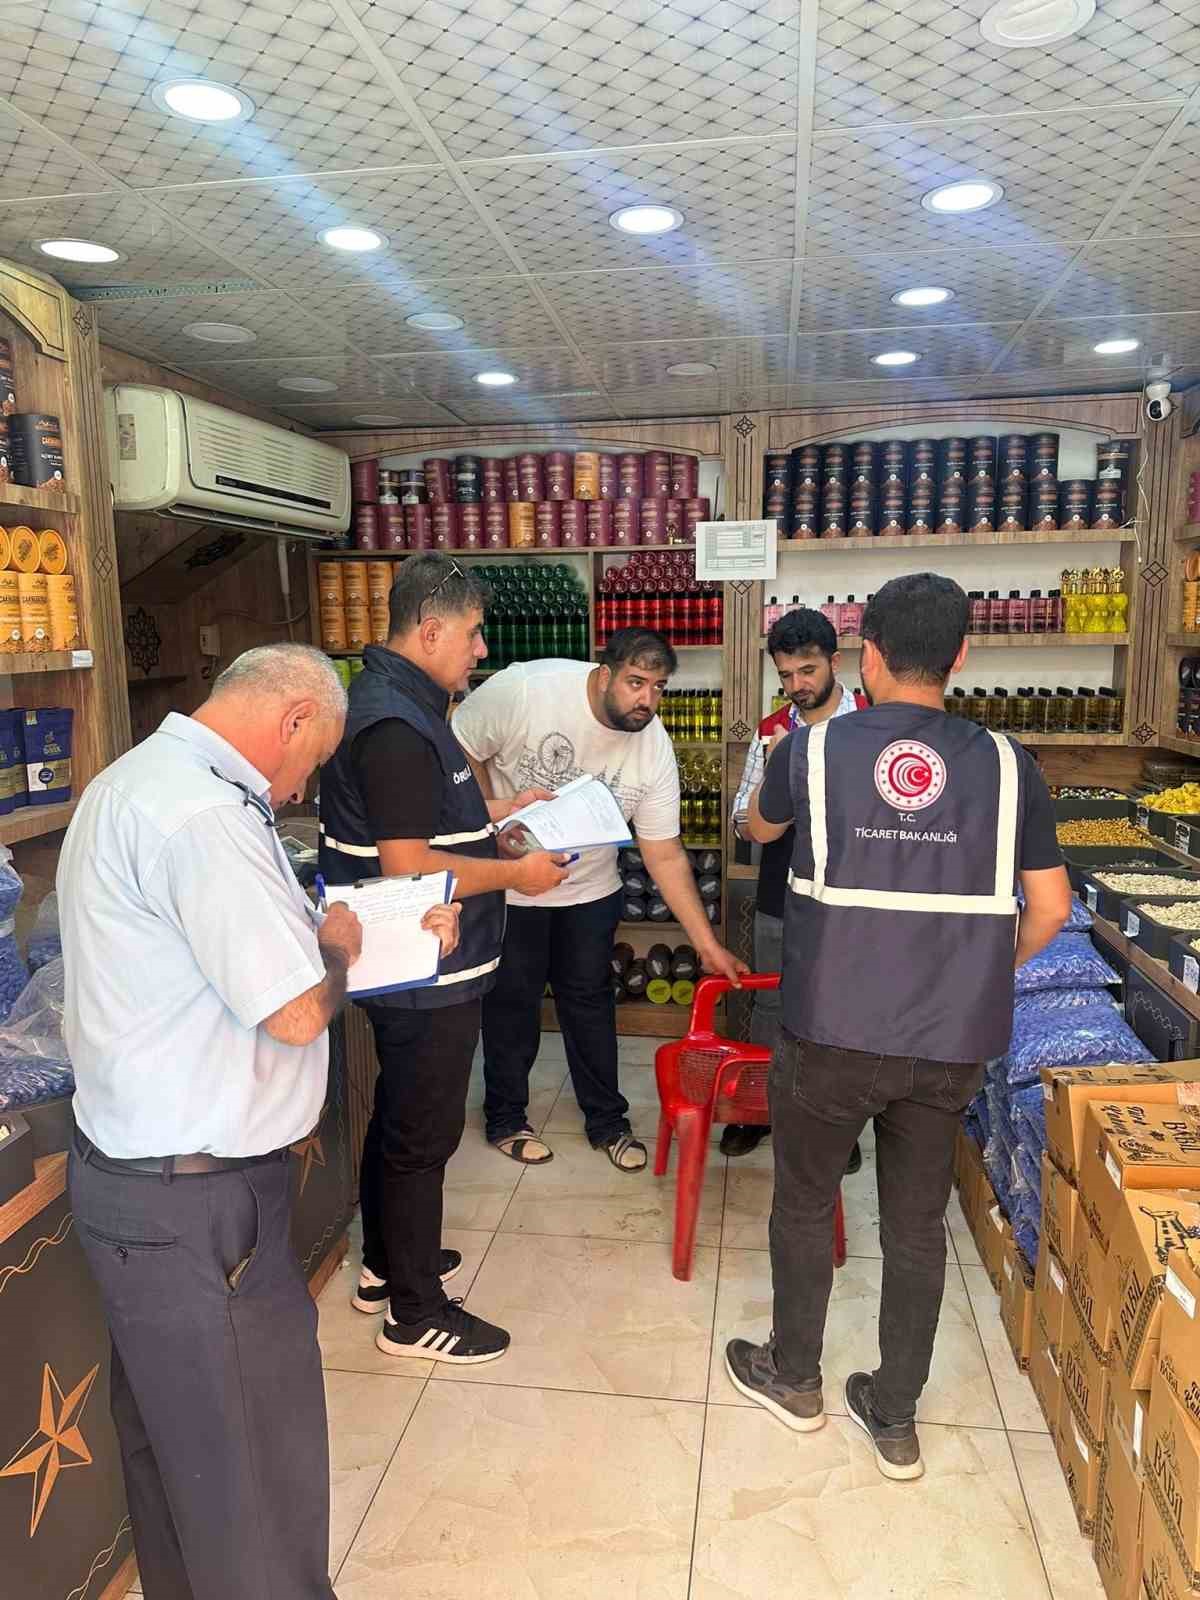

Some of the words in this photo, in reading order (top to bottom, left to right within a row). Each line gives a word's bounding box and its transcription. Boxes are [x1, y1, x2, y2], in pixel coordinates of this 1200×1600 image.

[897, 812, 917, 823] T.C.
[855, 826, 898, 840] TİCARET
[899, 829, 958, 844] BAKANLIĞI
